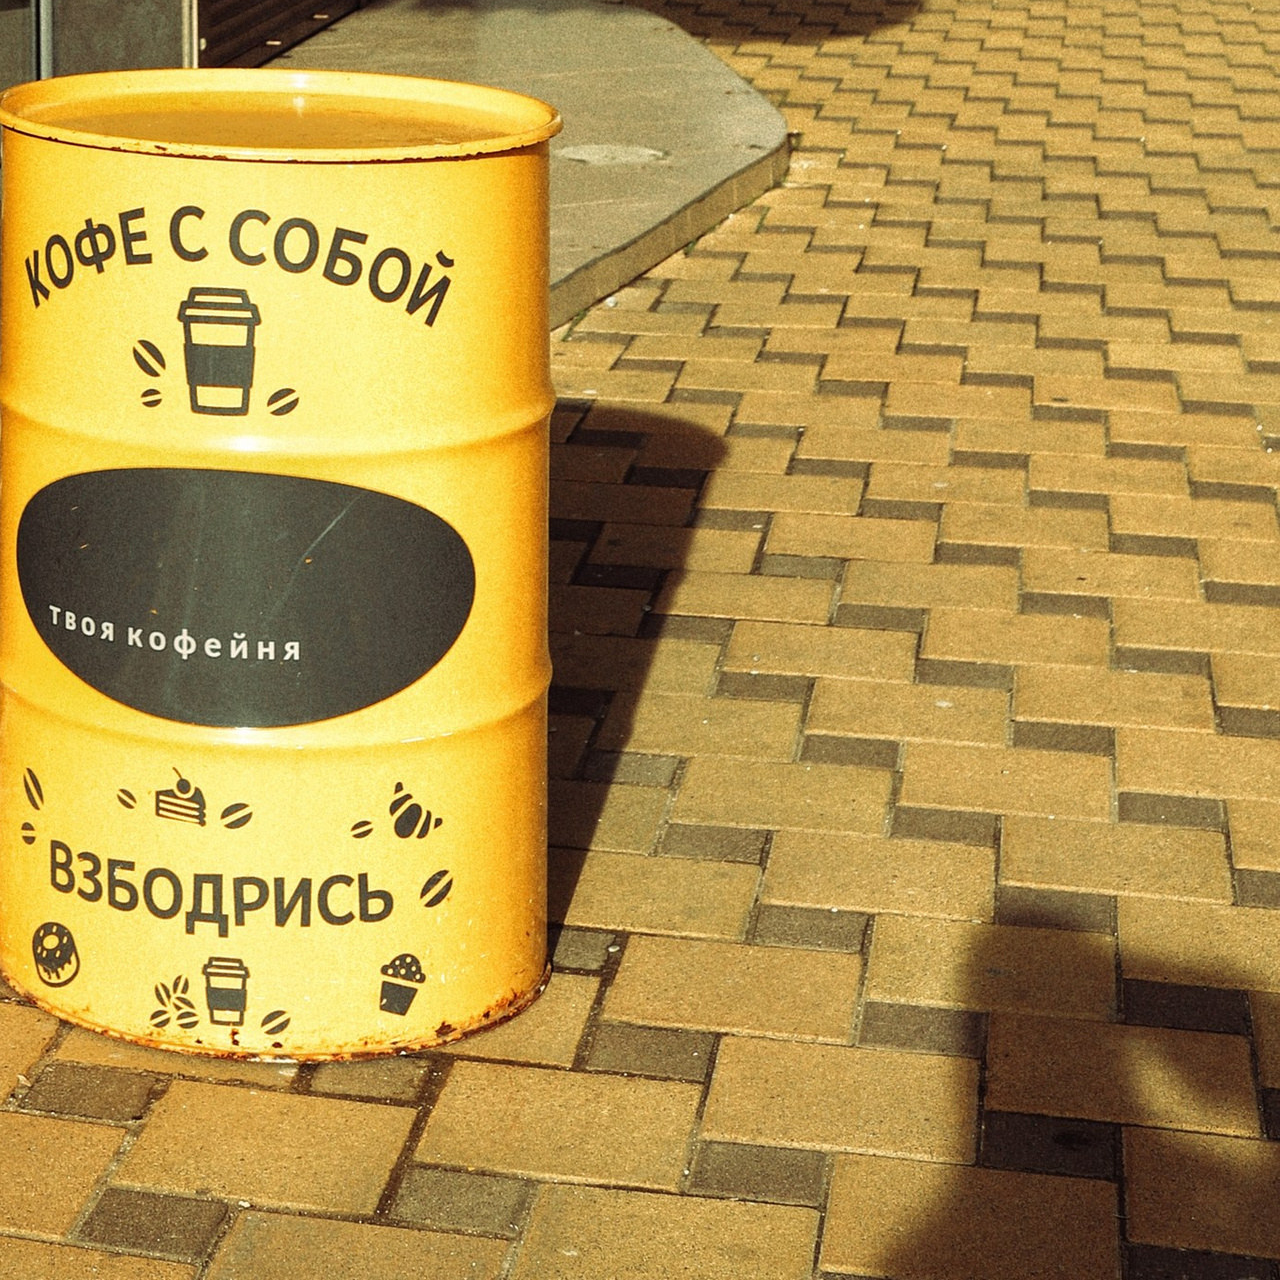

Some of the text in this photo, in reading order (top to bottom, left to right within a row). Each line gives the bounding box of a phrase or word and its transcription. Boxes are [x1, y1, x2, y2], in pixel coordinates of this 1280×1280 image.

[24, 205, 456, 328] КОФЕ С СОБОЙ
[127, 626, 301, 661] кофейня
[49, 839, 395, 938] ВЗБОДРИСЬ
